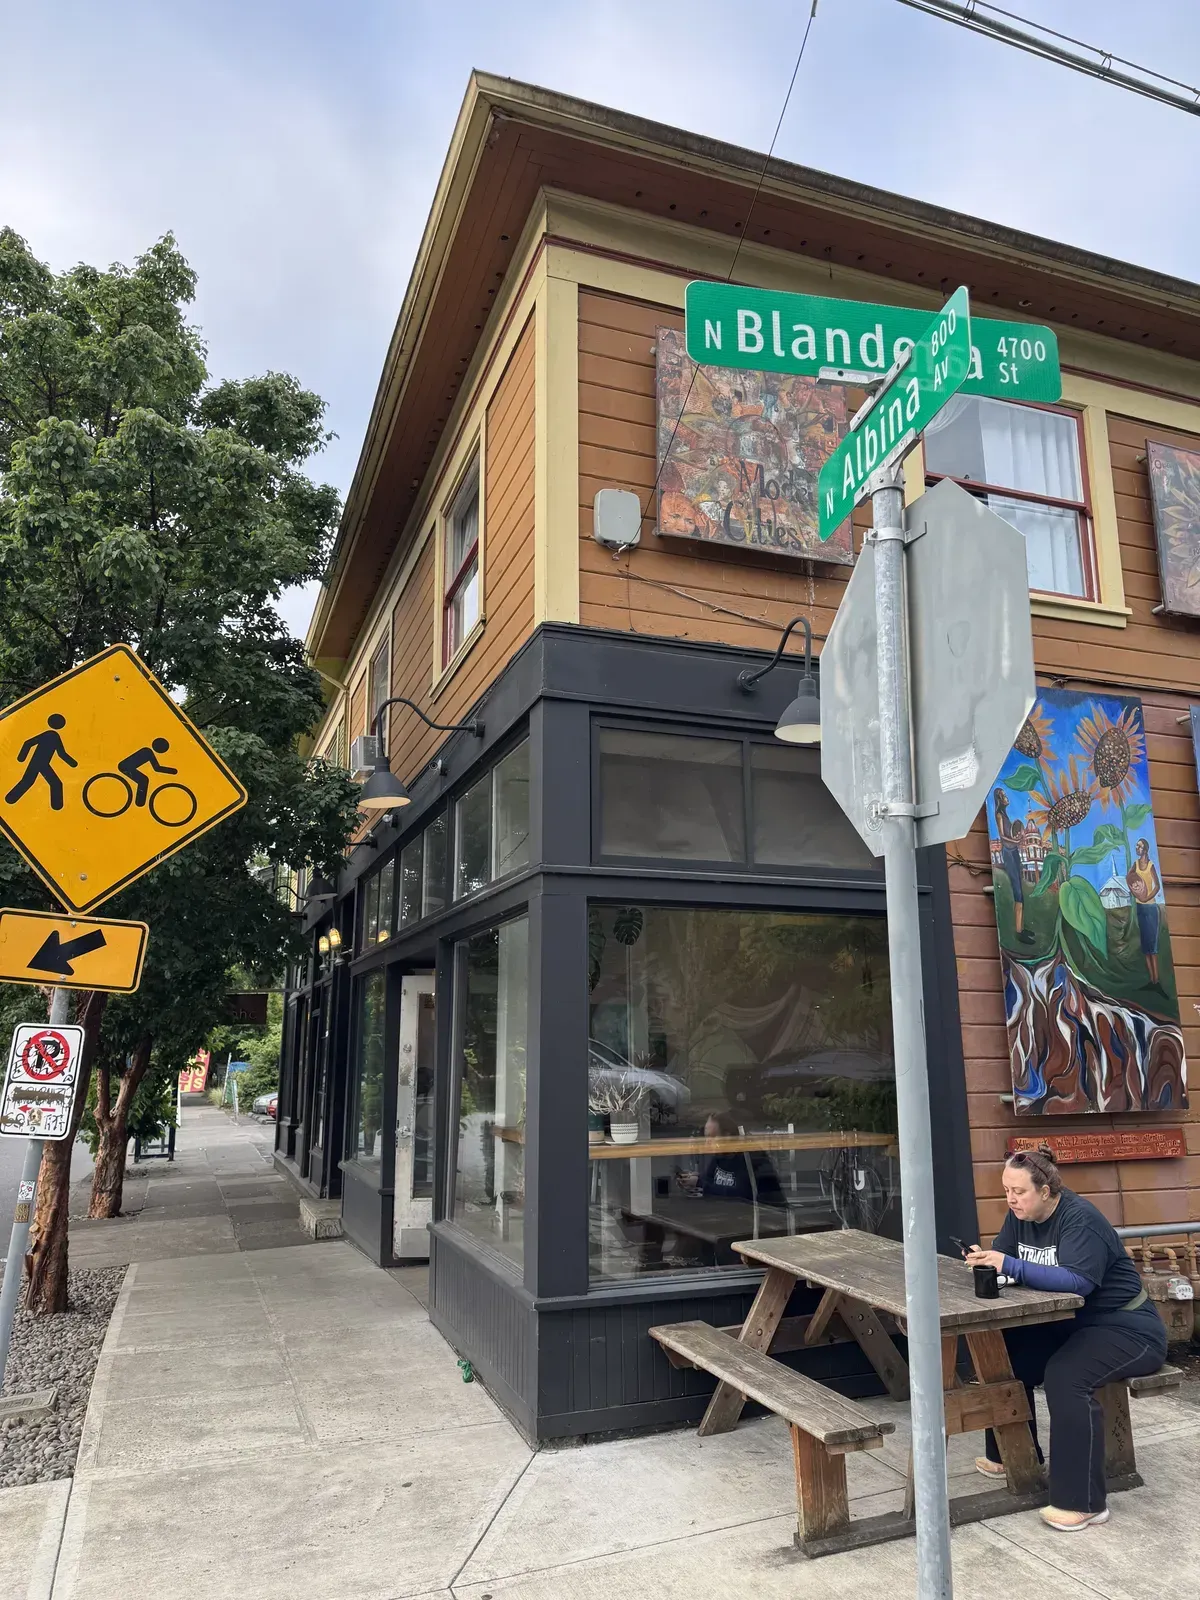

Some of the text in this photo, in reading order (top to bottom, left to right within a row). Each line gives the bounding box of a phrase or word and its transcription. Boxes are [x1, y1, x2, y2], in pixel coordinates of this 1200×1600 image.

[704, 308, 985, 380] N Blandea
[931, 308, 956, 357] 800
[997, 336, 1046, 362] 4700
[999, 361, 1020, 385] St
[825, 374, 921, 520] N Albina
